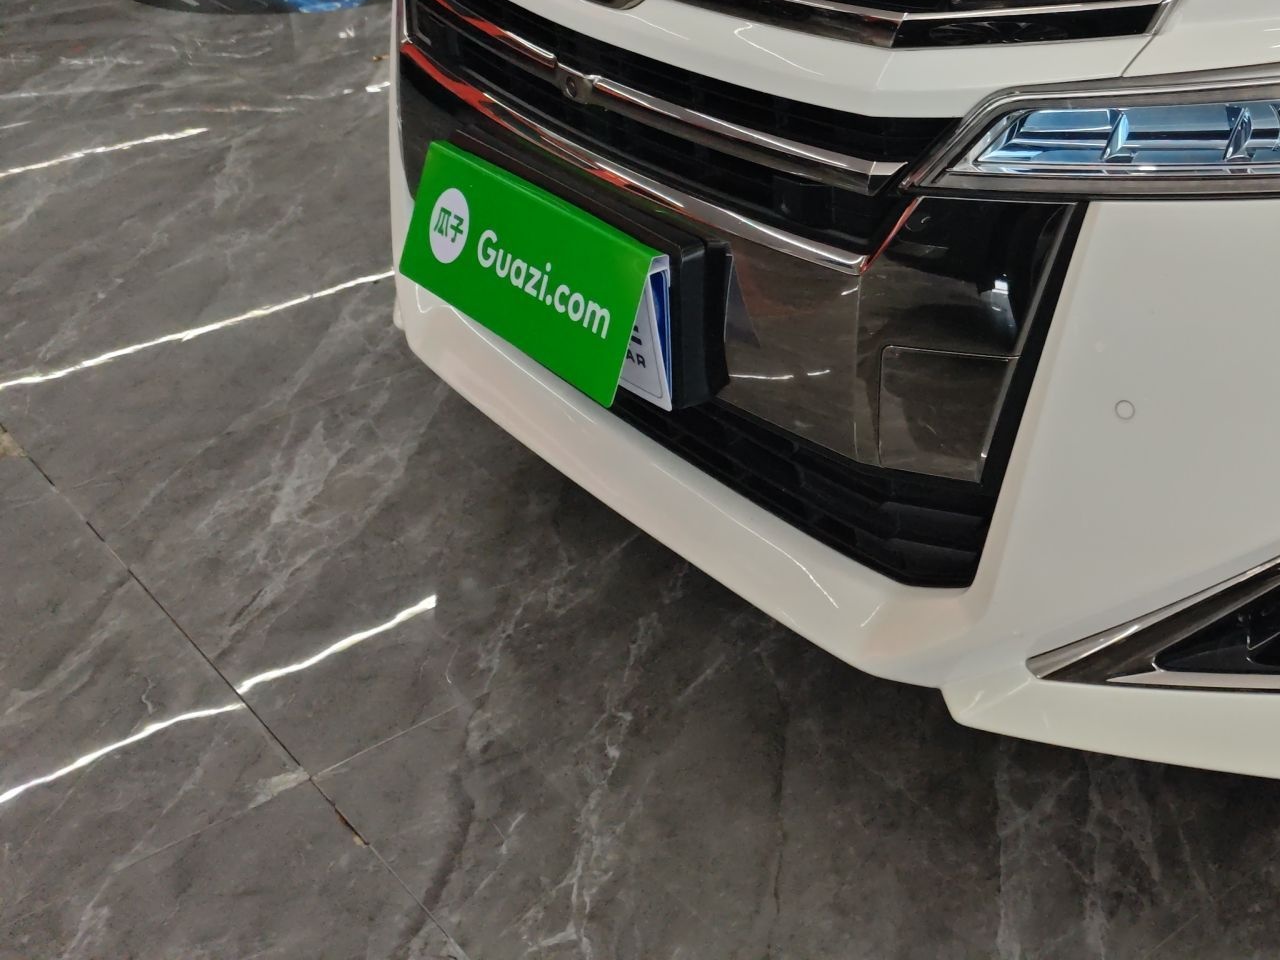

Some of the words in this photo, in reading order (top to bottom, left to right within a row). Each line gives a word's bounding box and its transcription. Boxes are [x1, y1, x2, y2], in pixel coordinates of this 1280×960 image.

[433, 207, 465, 243] 瓜子
[477, 228, 611, 339] Guazi.com
[626, 350, 647, 369] AR
